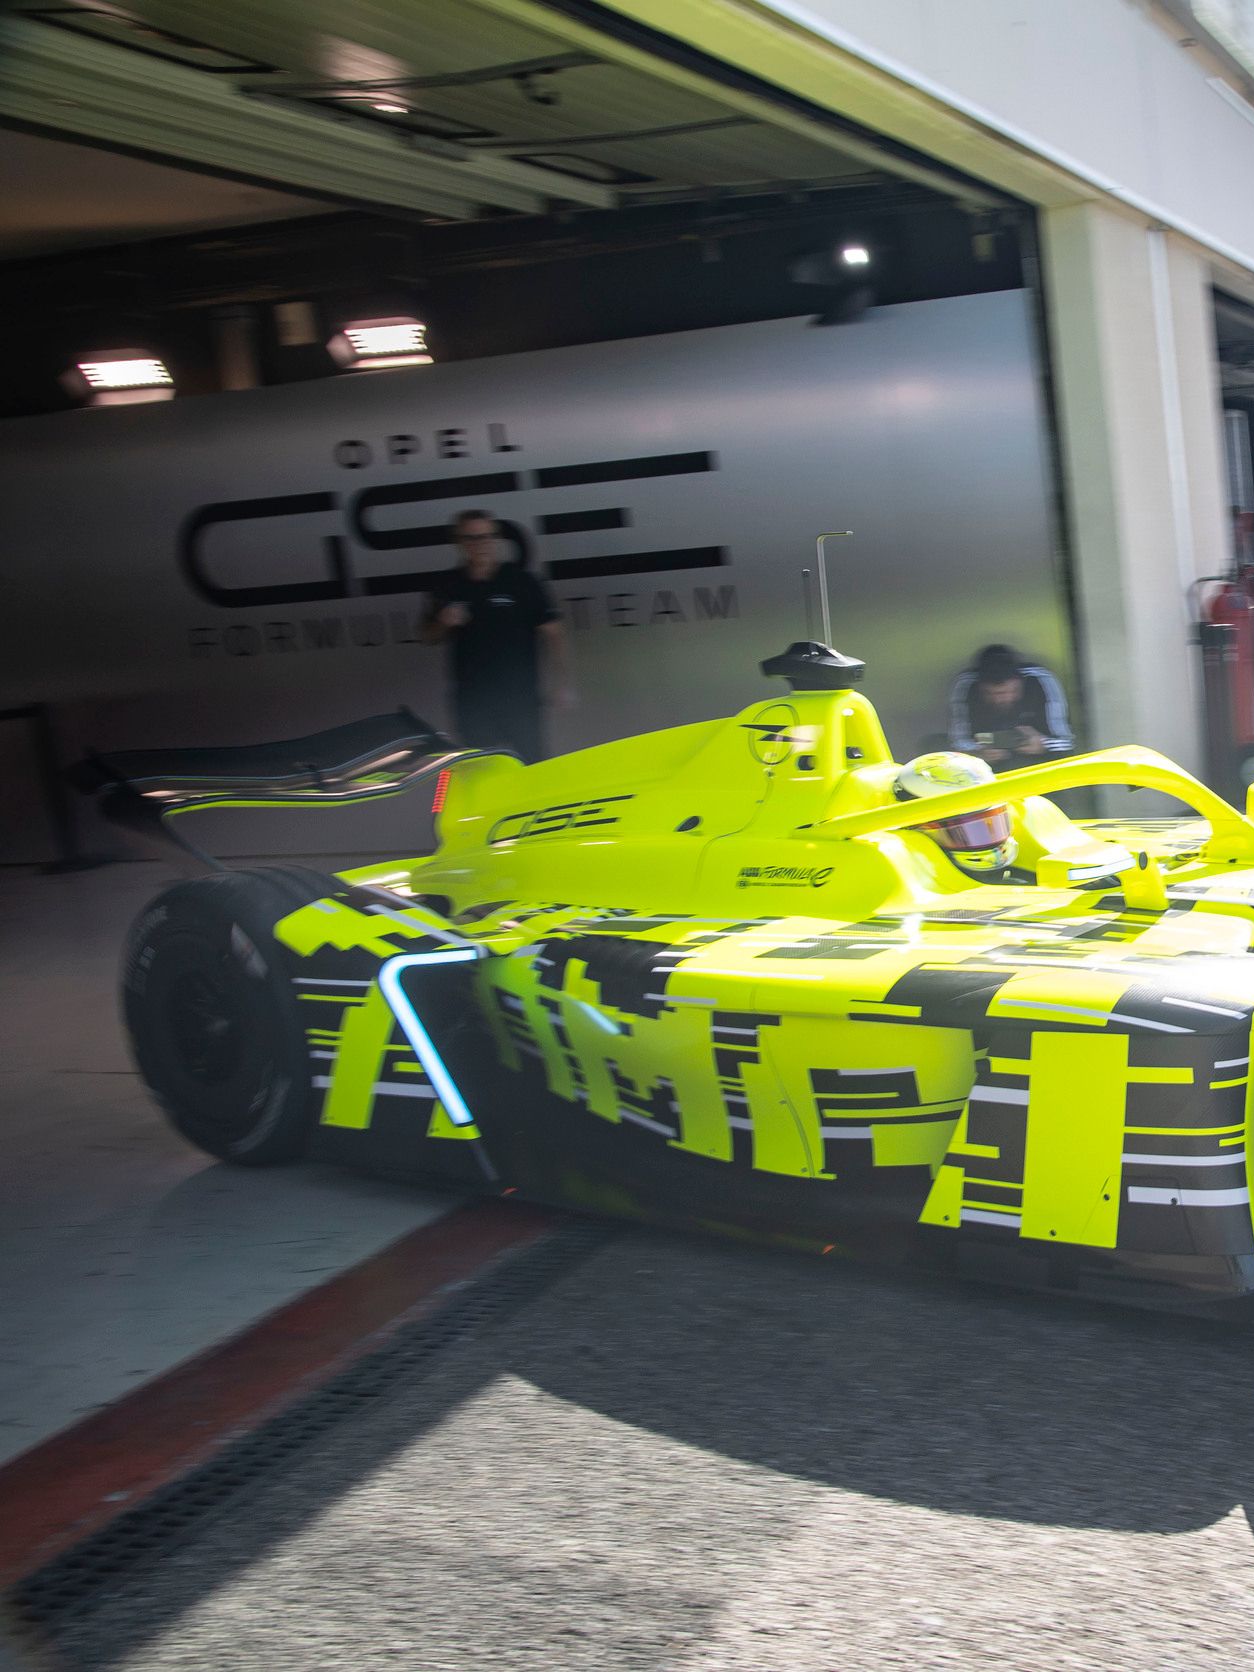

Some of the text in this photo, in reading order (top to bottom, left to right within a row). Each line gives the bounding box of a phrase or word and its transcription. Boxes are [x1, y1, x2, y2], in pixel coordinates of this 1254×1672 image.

[334, 424, 523, 470] OPEL
[176, 450, 732, 609] GSE
[188, 584, 741, 656] FORMUL TEAM
[487, 793, 638, 846] GSE
